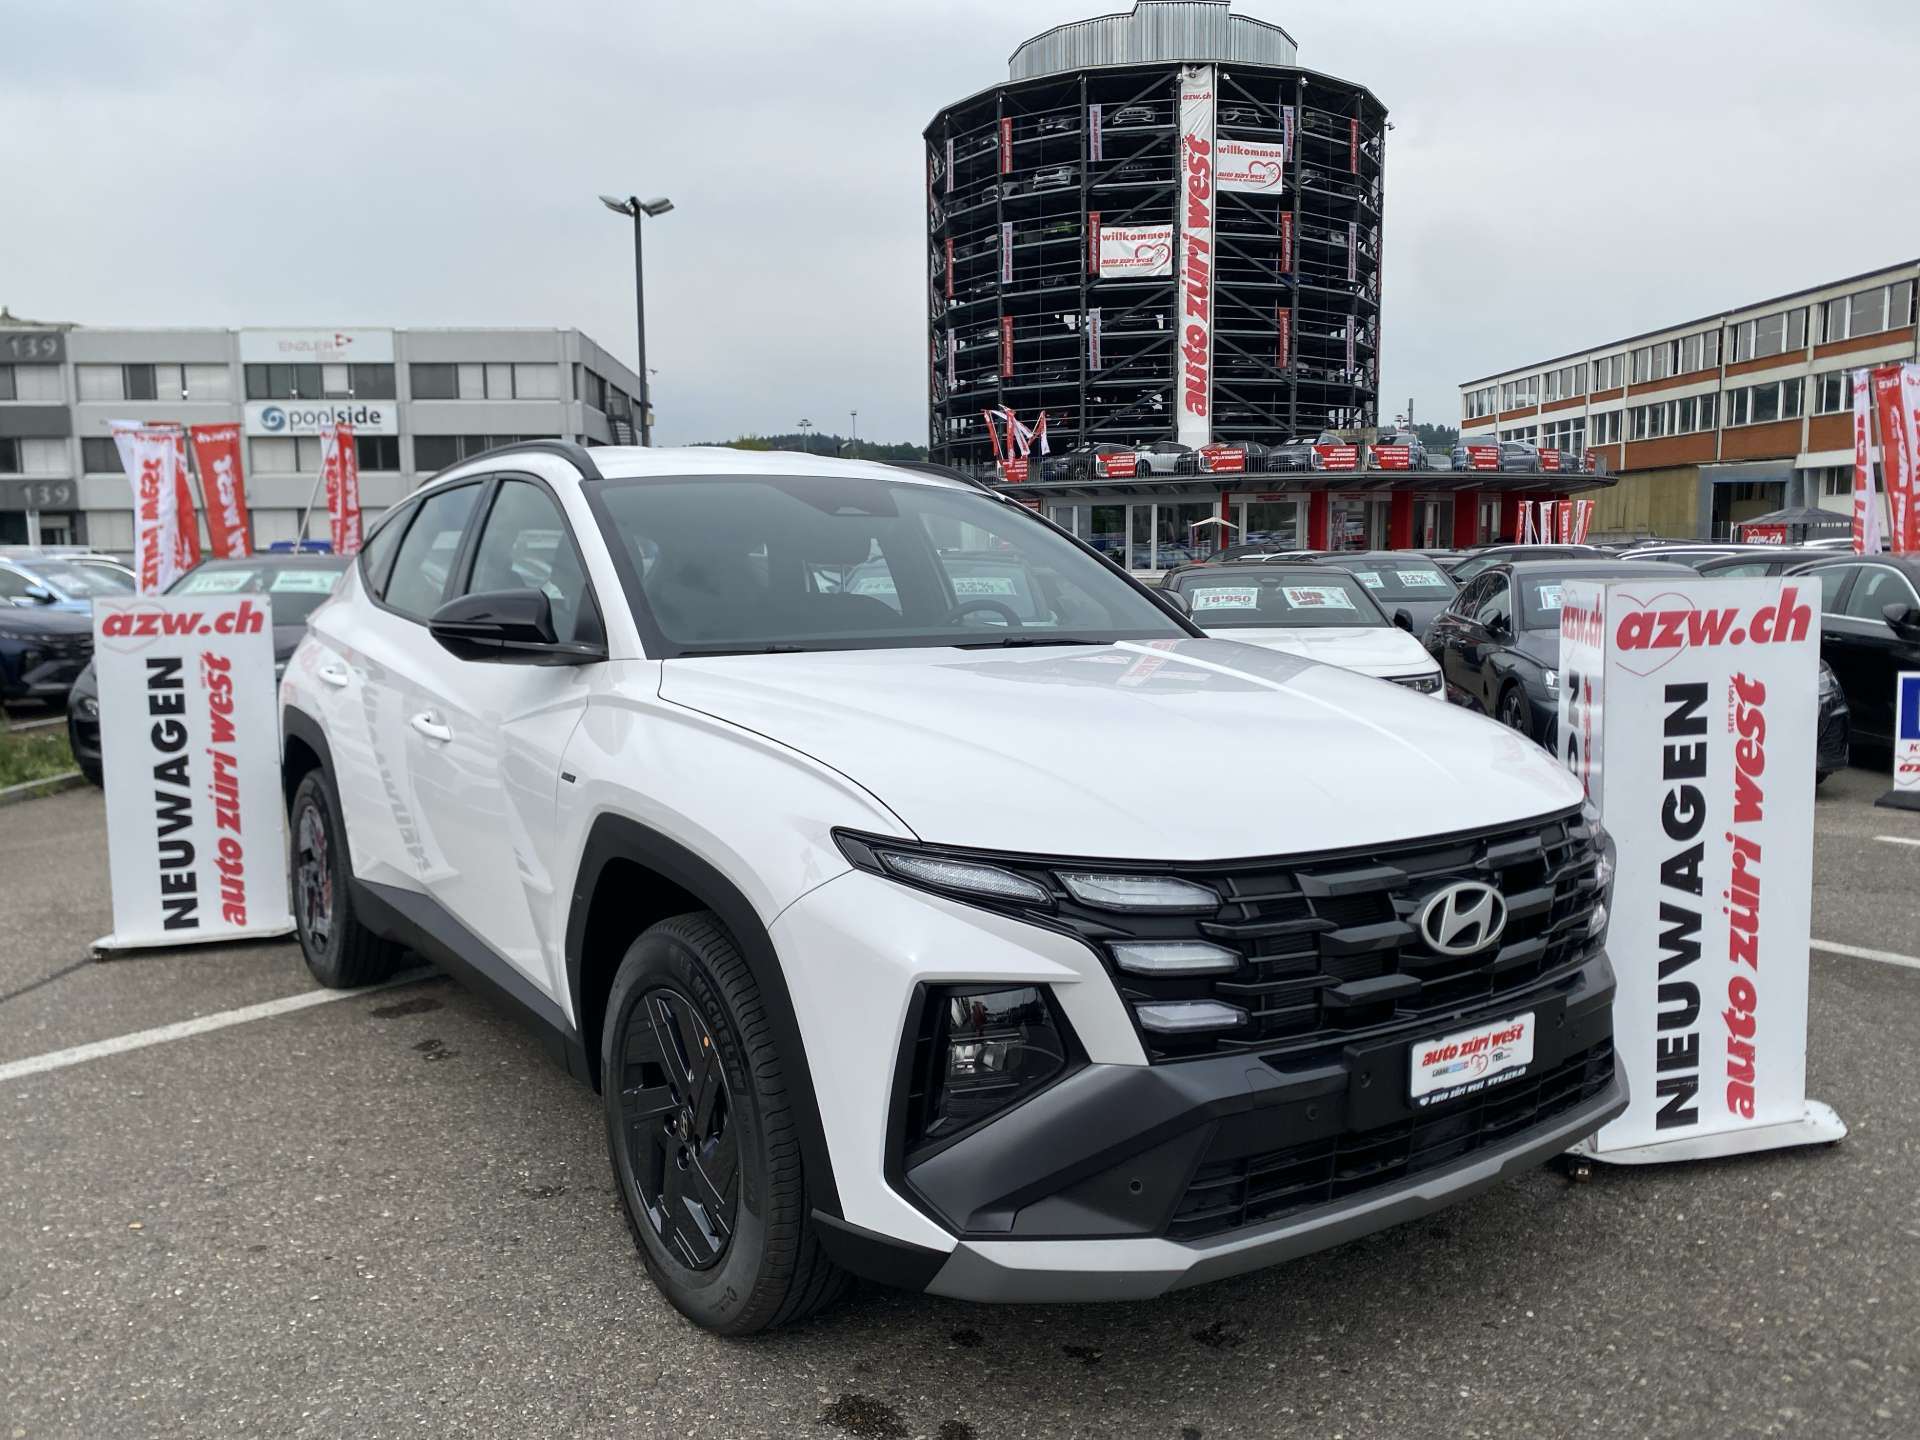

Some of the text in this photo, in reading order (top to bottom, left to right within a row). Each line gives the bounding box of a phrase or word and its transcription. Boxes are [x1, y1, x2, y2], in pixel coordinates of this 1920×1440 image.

[1182, 92, 1212, 100] azw.ch
[1218, 145, 1281, 158] willkommen
[1102, 231, 1171, 241] willkommen
[1180, 133, 1211, 417] auto züri west
[10, 336, 57, 358] 139
[289, 406, 381, 432] poolside
[23, 485, 70, 504] 139
[103, 601, 264, 637] azw.ch
[1616, 587, 1811, 652] azw.ch
[1727, 715, 1736, 734] SEIT
[146, 657, 199, 931] NEUWAGEN
[200, 651, 247, 927] auto züri west
[1655, 682, 1708, 1131] NEUWAGEN
[1720, 672, 1767, 1121] auto züri west
[1422, 1044, 1458, 1067] auto
[1459, 1032, 1491, 1057] züri
[1491, 1023, 1525, 1047] west
[1430, 1092, 1448, 1104] auto
